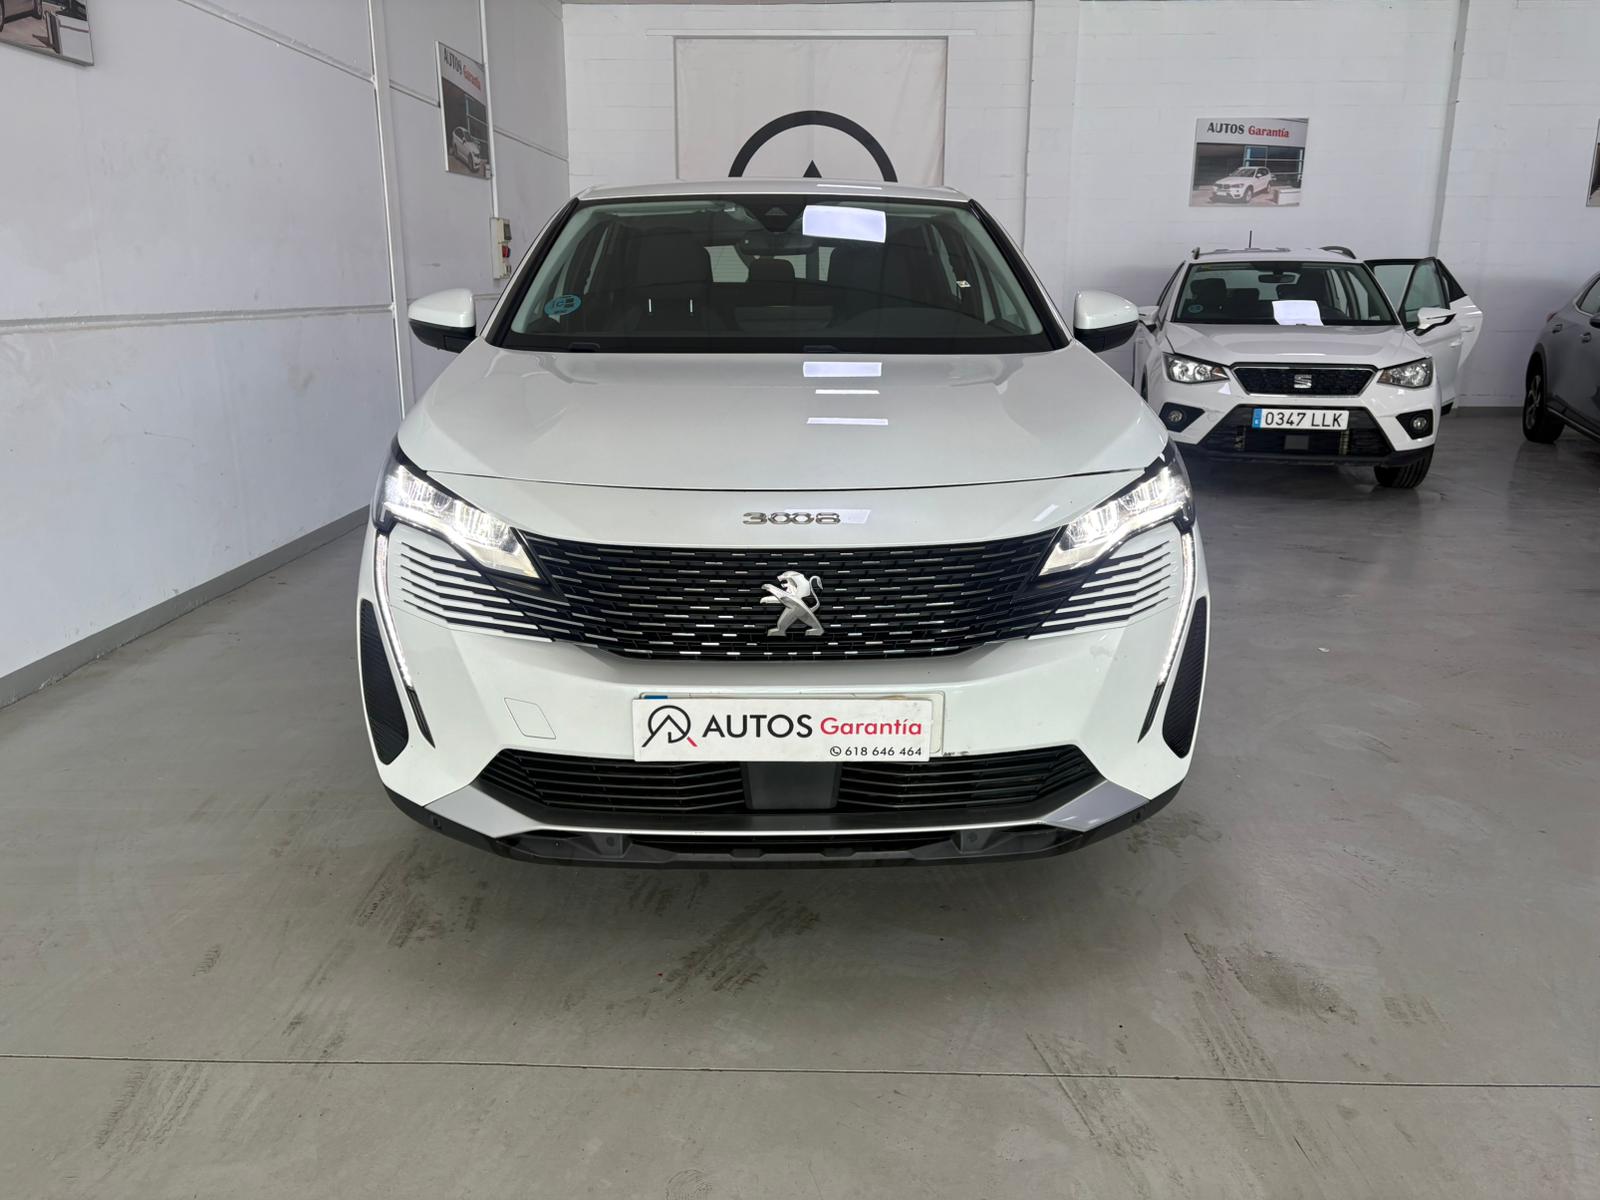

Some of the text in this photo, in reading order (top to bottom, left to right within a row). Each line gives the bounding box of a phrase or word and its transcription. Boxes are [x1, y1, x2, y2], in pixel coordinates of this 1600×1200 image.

[1207, 122, 1290, 138] AUTOS Garantía
[1265, 412, 1306, 427] 0347
[1311, 413, 1343, 428] LLK
[742, 512, 841, 525] 3008
[702, 714, 922, 738] AUTOS Garantía
[845, 745, 922, 757] 618 646 464
